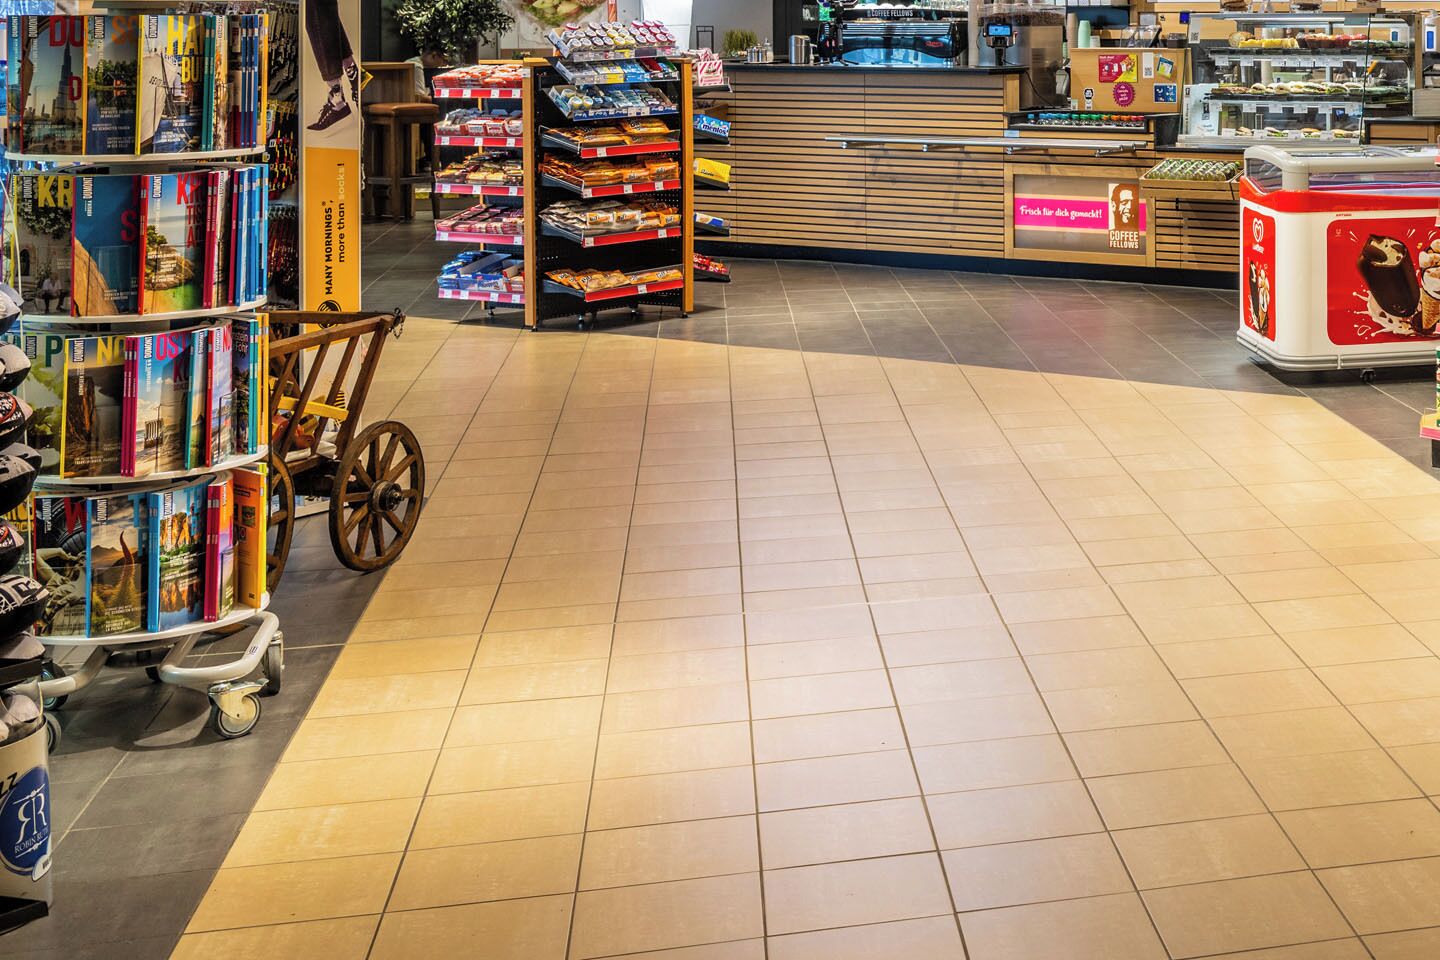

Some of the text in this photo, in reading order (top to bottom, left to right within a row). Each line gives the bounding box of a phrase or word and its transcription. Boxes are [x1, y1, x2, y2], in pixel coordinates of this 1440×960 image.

[871, 9, 914, 17] COFFEE FELLOWS
[28, 16, 37, 37] DUMONT
[94, 16, 104, 38] DUMONT
[149, 16, 157, 37] DUMONT
[702, 124, 729, 135] mentos
[23, 176, 32, 199] DUMONT
[83, 177, 92, 199] DUMONT
[153, 176, 162, 198] DUMONT
[1019, 205, 1103, 220] Frisch für dich gemacht!
[1109, 230, 1139, 242] COFFEE
[1109, 241, 1139, 249] FELLOWS
[325, 263, 333, 295] MANY
[26, 336, 36, 359] DUMONT
[73, 339, 84, 362] DUMONT
[144, 336, 153, 358] DUMONT
[44, 499, 52, 520] DUMONT
[96, 499, 107, 521] DUMONT
[164, 492, 172, 515] DUMONT
